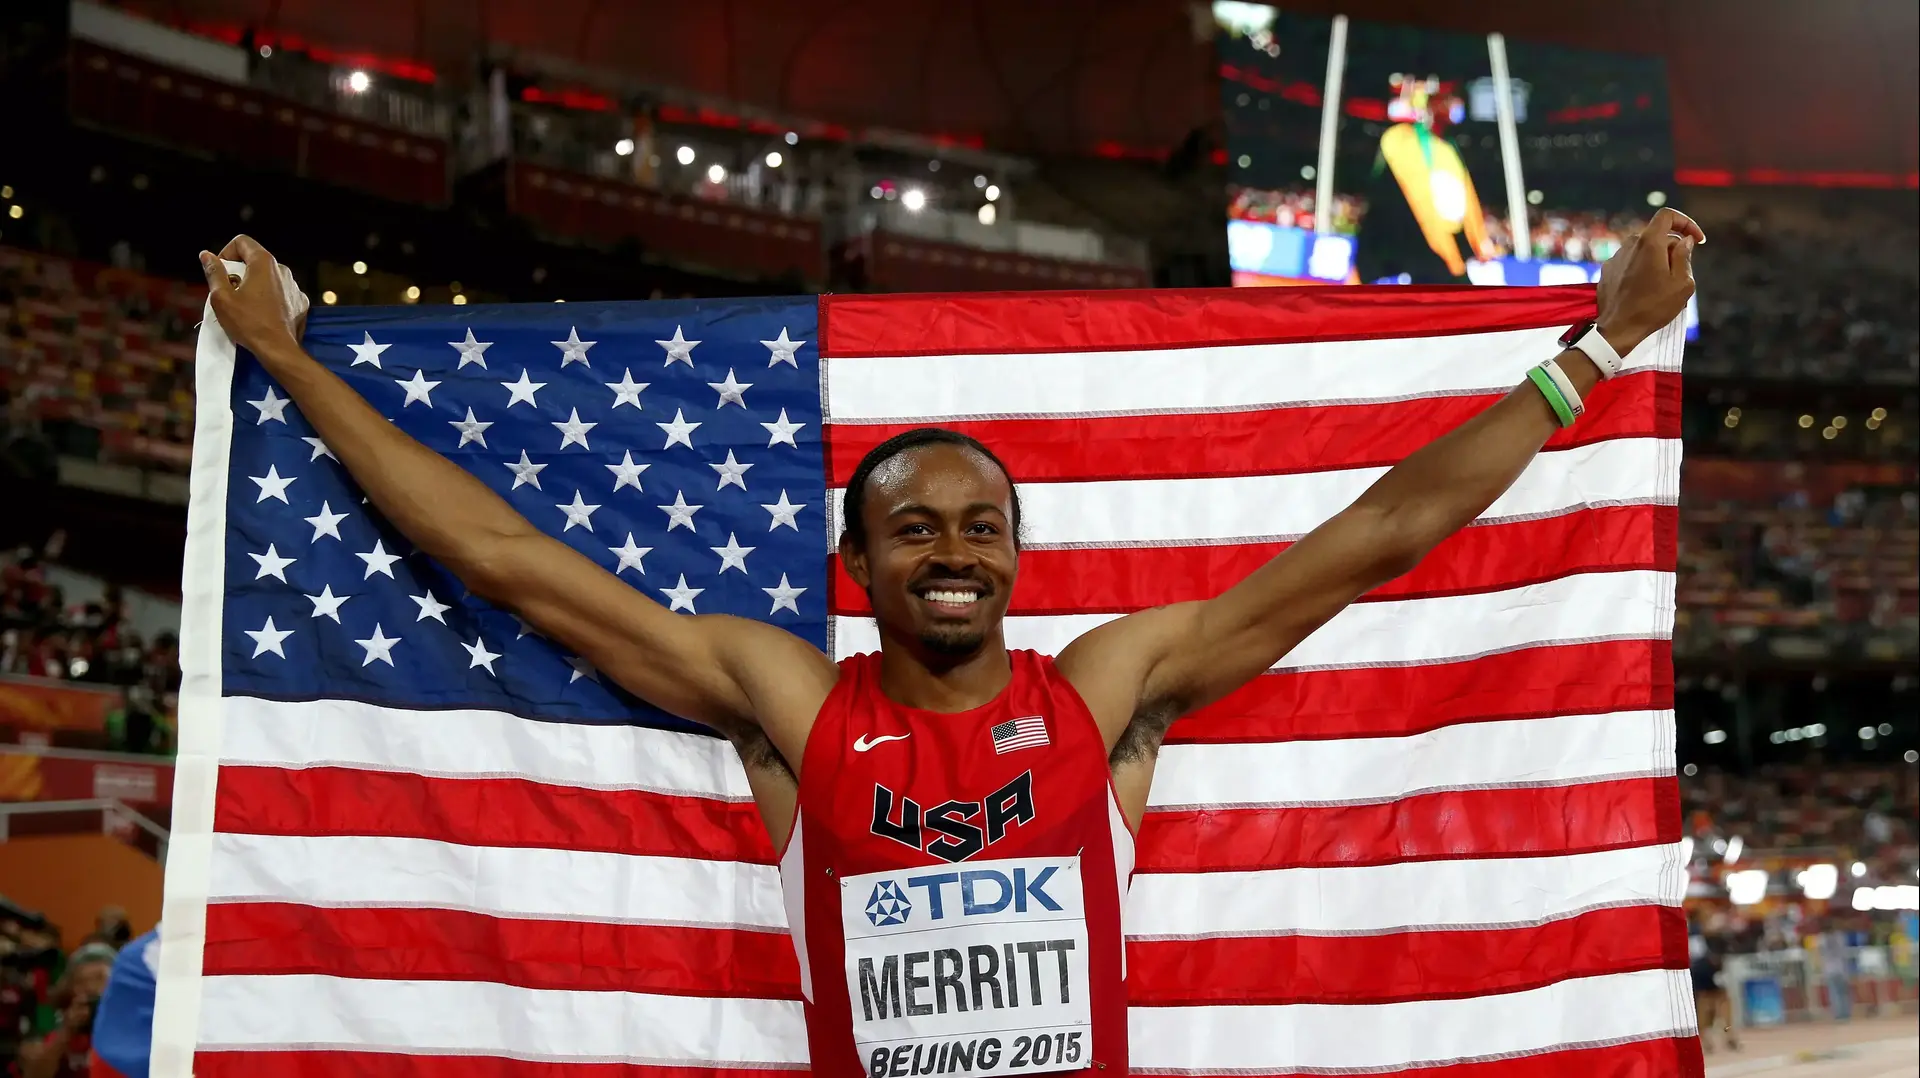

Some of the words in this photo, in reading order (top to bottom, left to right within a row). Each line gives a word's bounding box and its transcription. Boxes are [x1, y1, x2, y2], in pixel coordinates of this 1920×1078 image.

[870, 769, 1035, 863] USA
[908, 866, 1064, 920] TDK
[858, 939, 1075, 1021] MERRITT
[870, 1038, 1002, 1078] BEIJING
[1010, 1031, 1083, 1067] 2015
